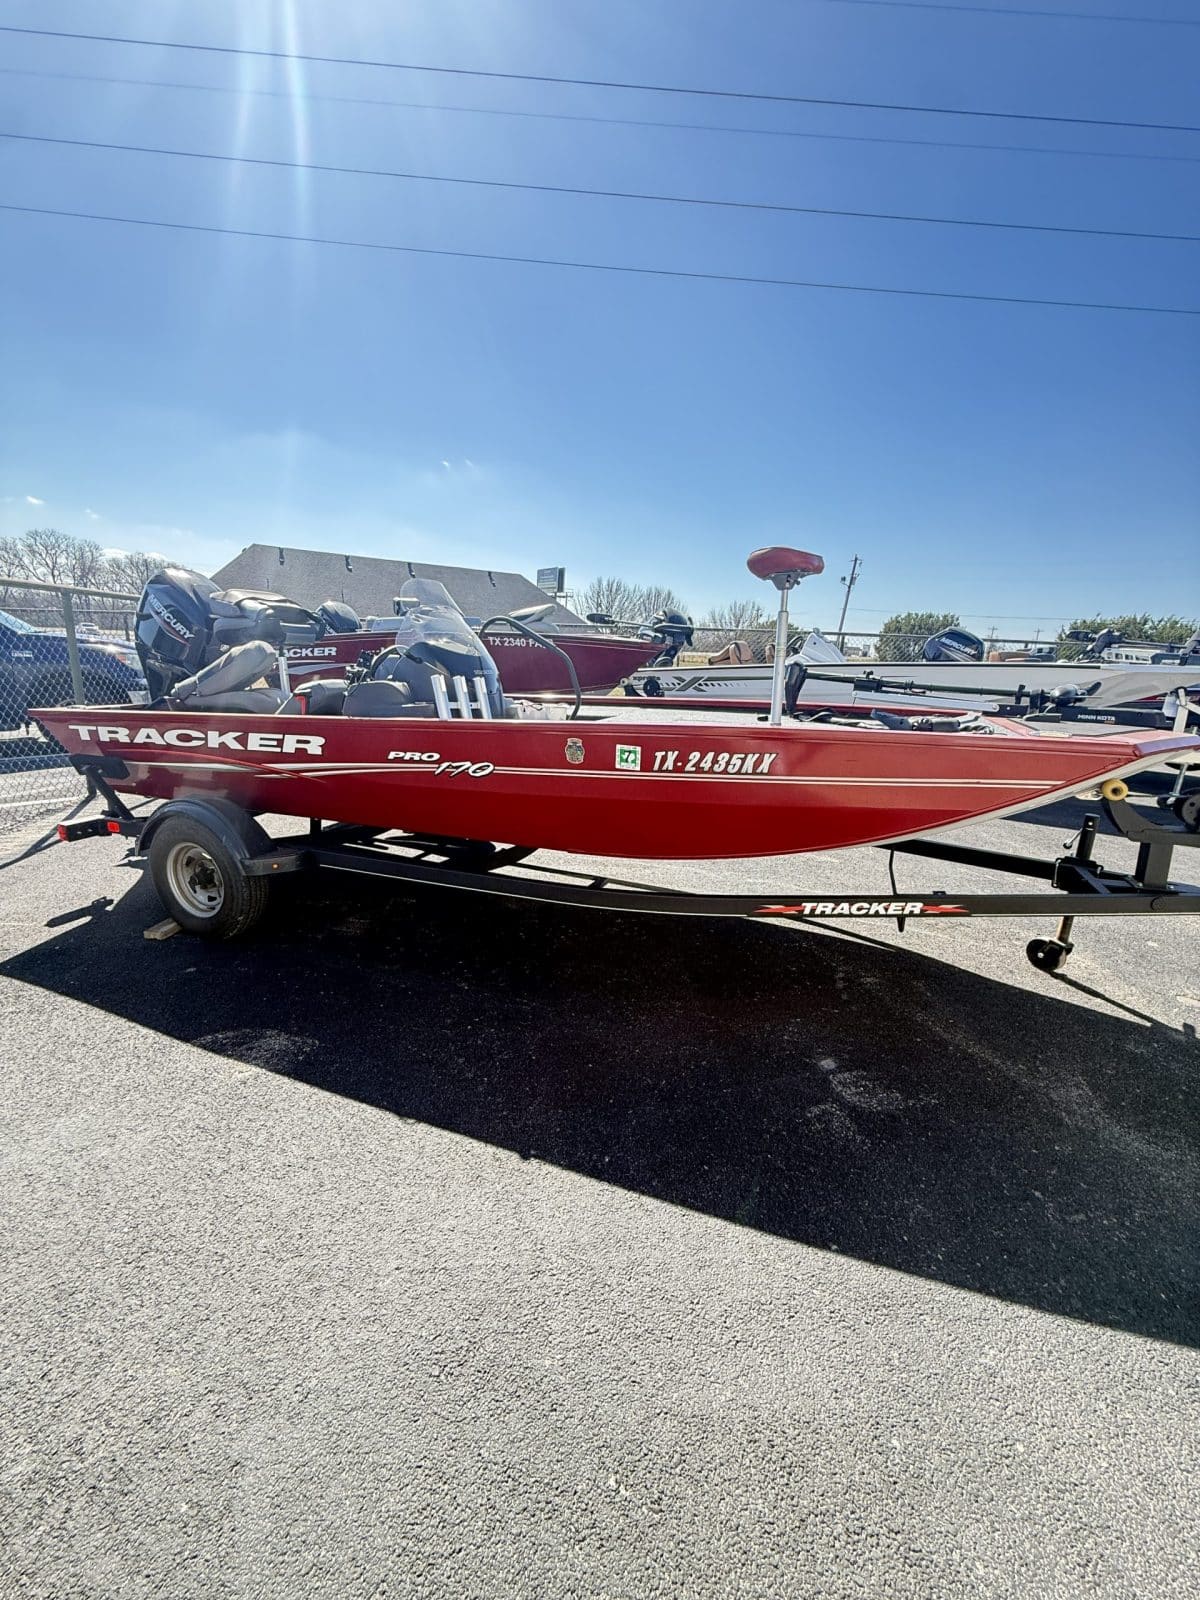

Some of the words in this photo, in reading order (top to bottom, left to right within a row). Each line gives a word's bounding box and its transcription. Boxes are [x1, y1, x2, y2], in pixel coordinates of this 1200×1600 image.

[150, 593, 196, 639] MERCURY
[488, 637, 501, 646] TX
[504, 638, 527, 647] 2340
[68, 725, 327, 755] TRACKER
[387, 751, 441, 761] PRO
[653, 751, 777, 774] TX-2435KX
[434, 761, 495, 777] 170
[801, 902, 923, 915] TRACKER
